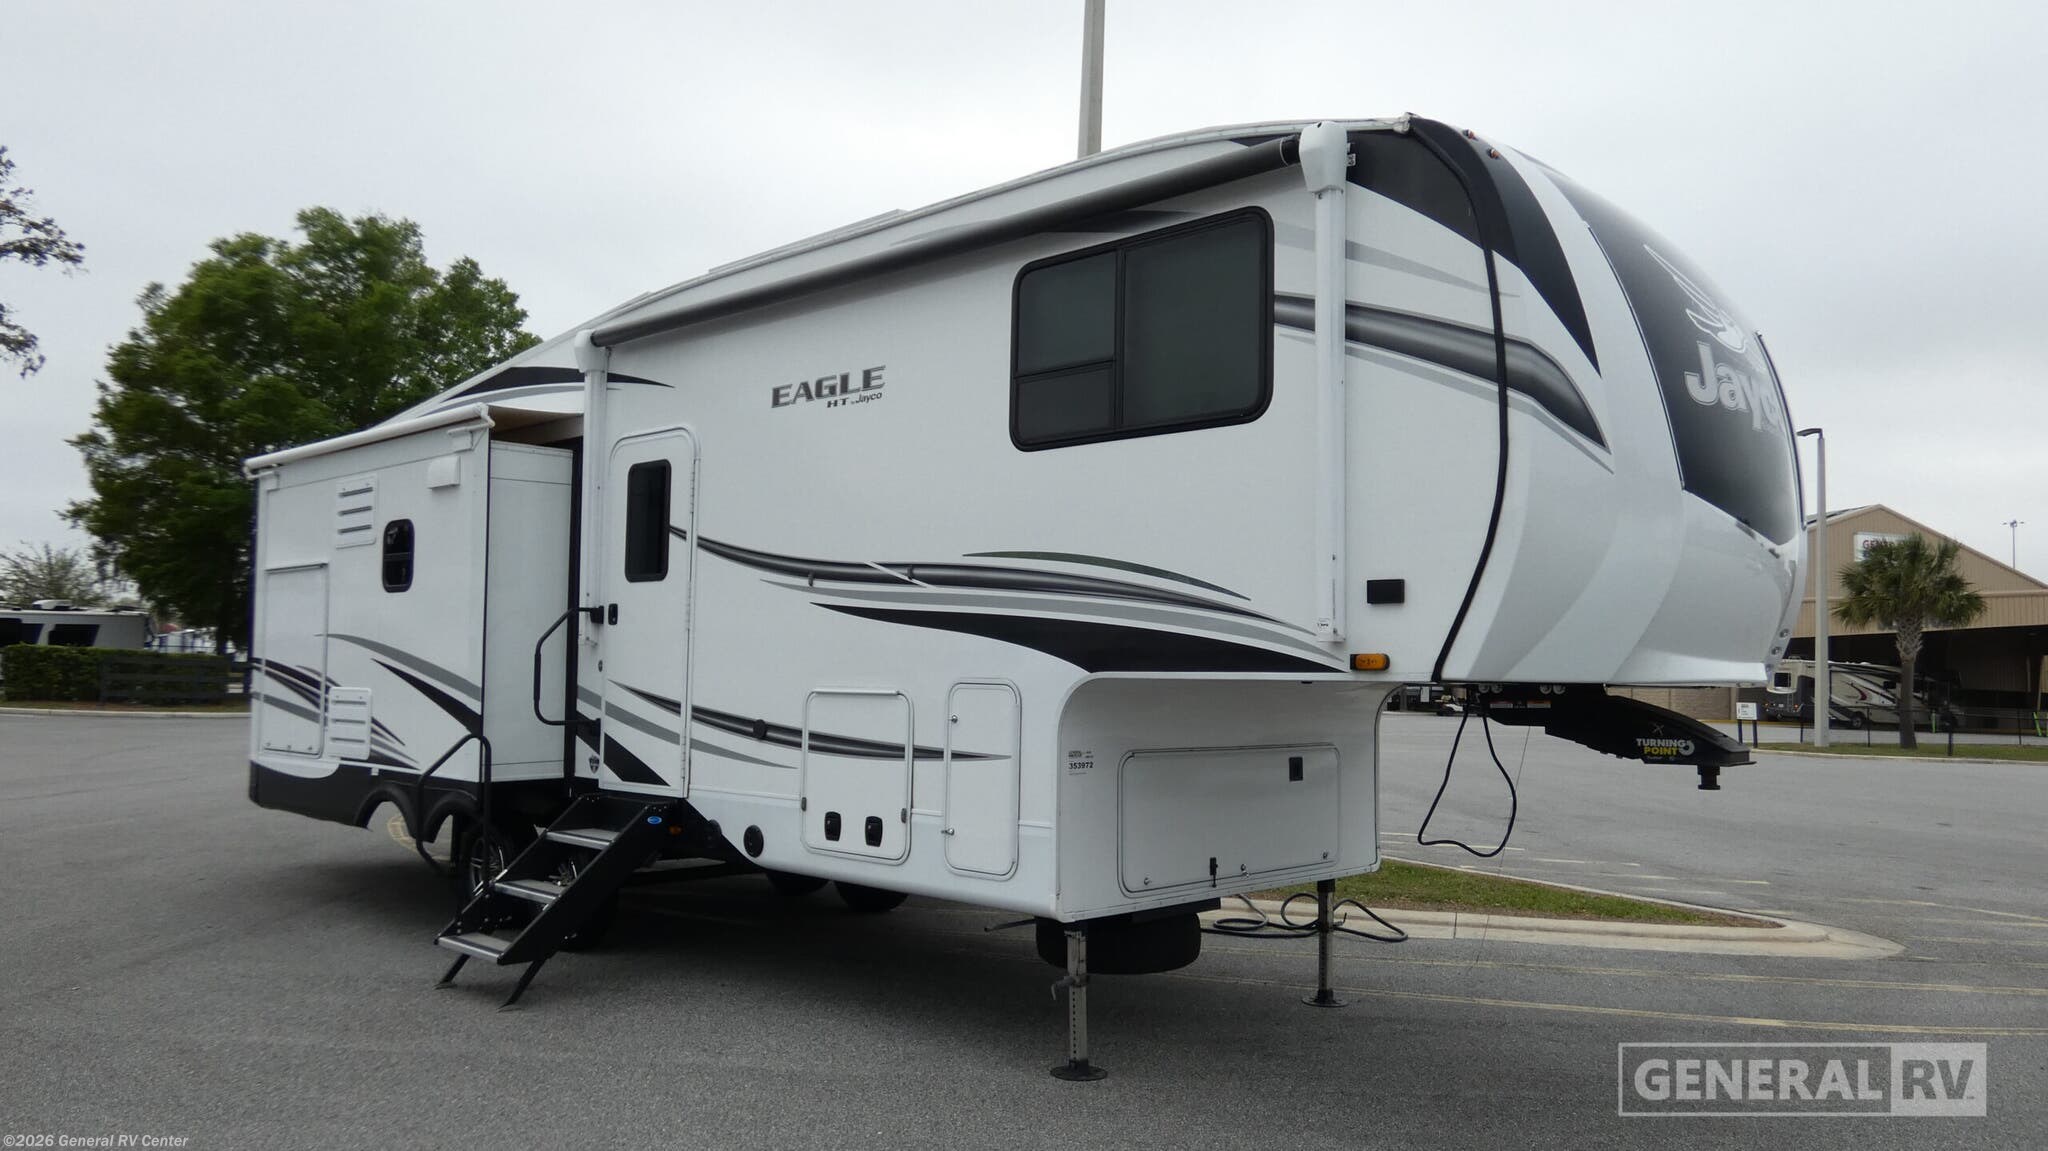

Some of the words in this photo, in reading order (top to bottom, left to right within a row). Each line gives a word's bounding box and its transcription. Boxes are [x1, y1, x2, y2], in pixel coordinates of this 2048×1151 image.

[771, 365, 886, 408] EAGLE
[827, 397, 848, 408] HT
[855, 392, 882, 404] Jayco
[1636, 738, 1687, 748] TURNING
[1643, 746, 1678, 756] POINT
[1069, 761, 1094, 770] 353972
